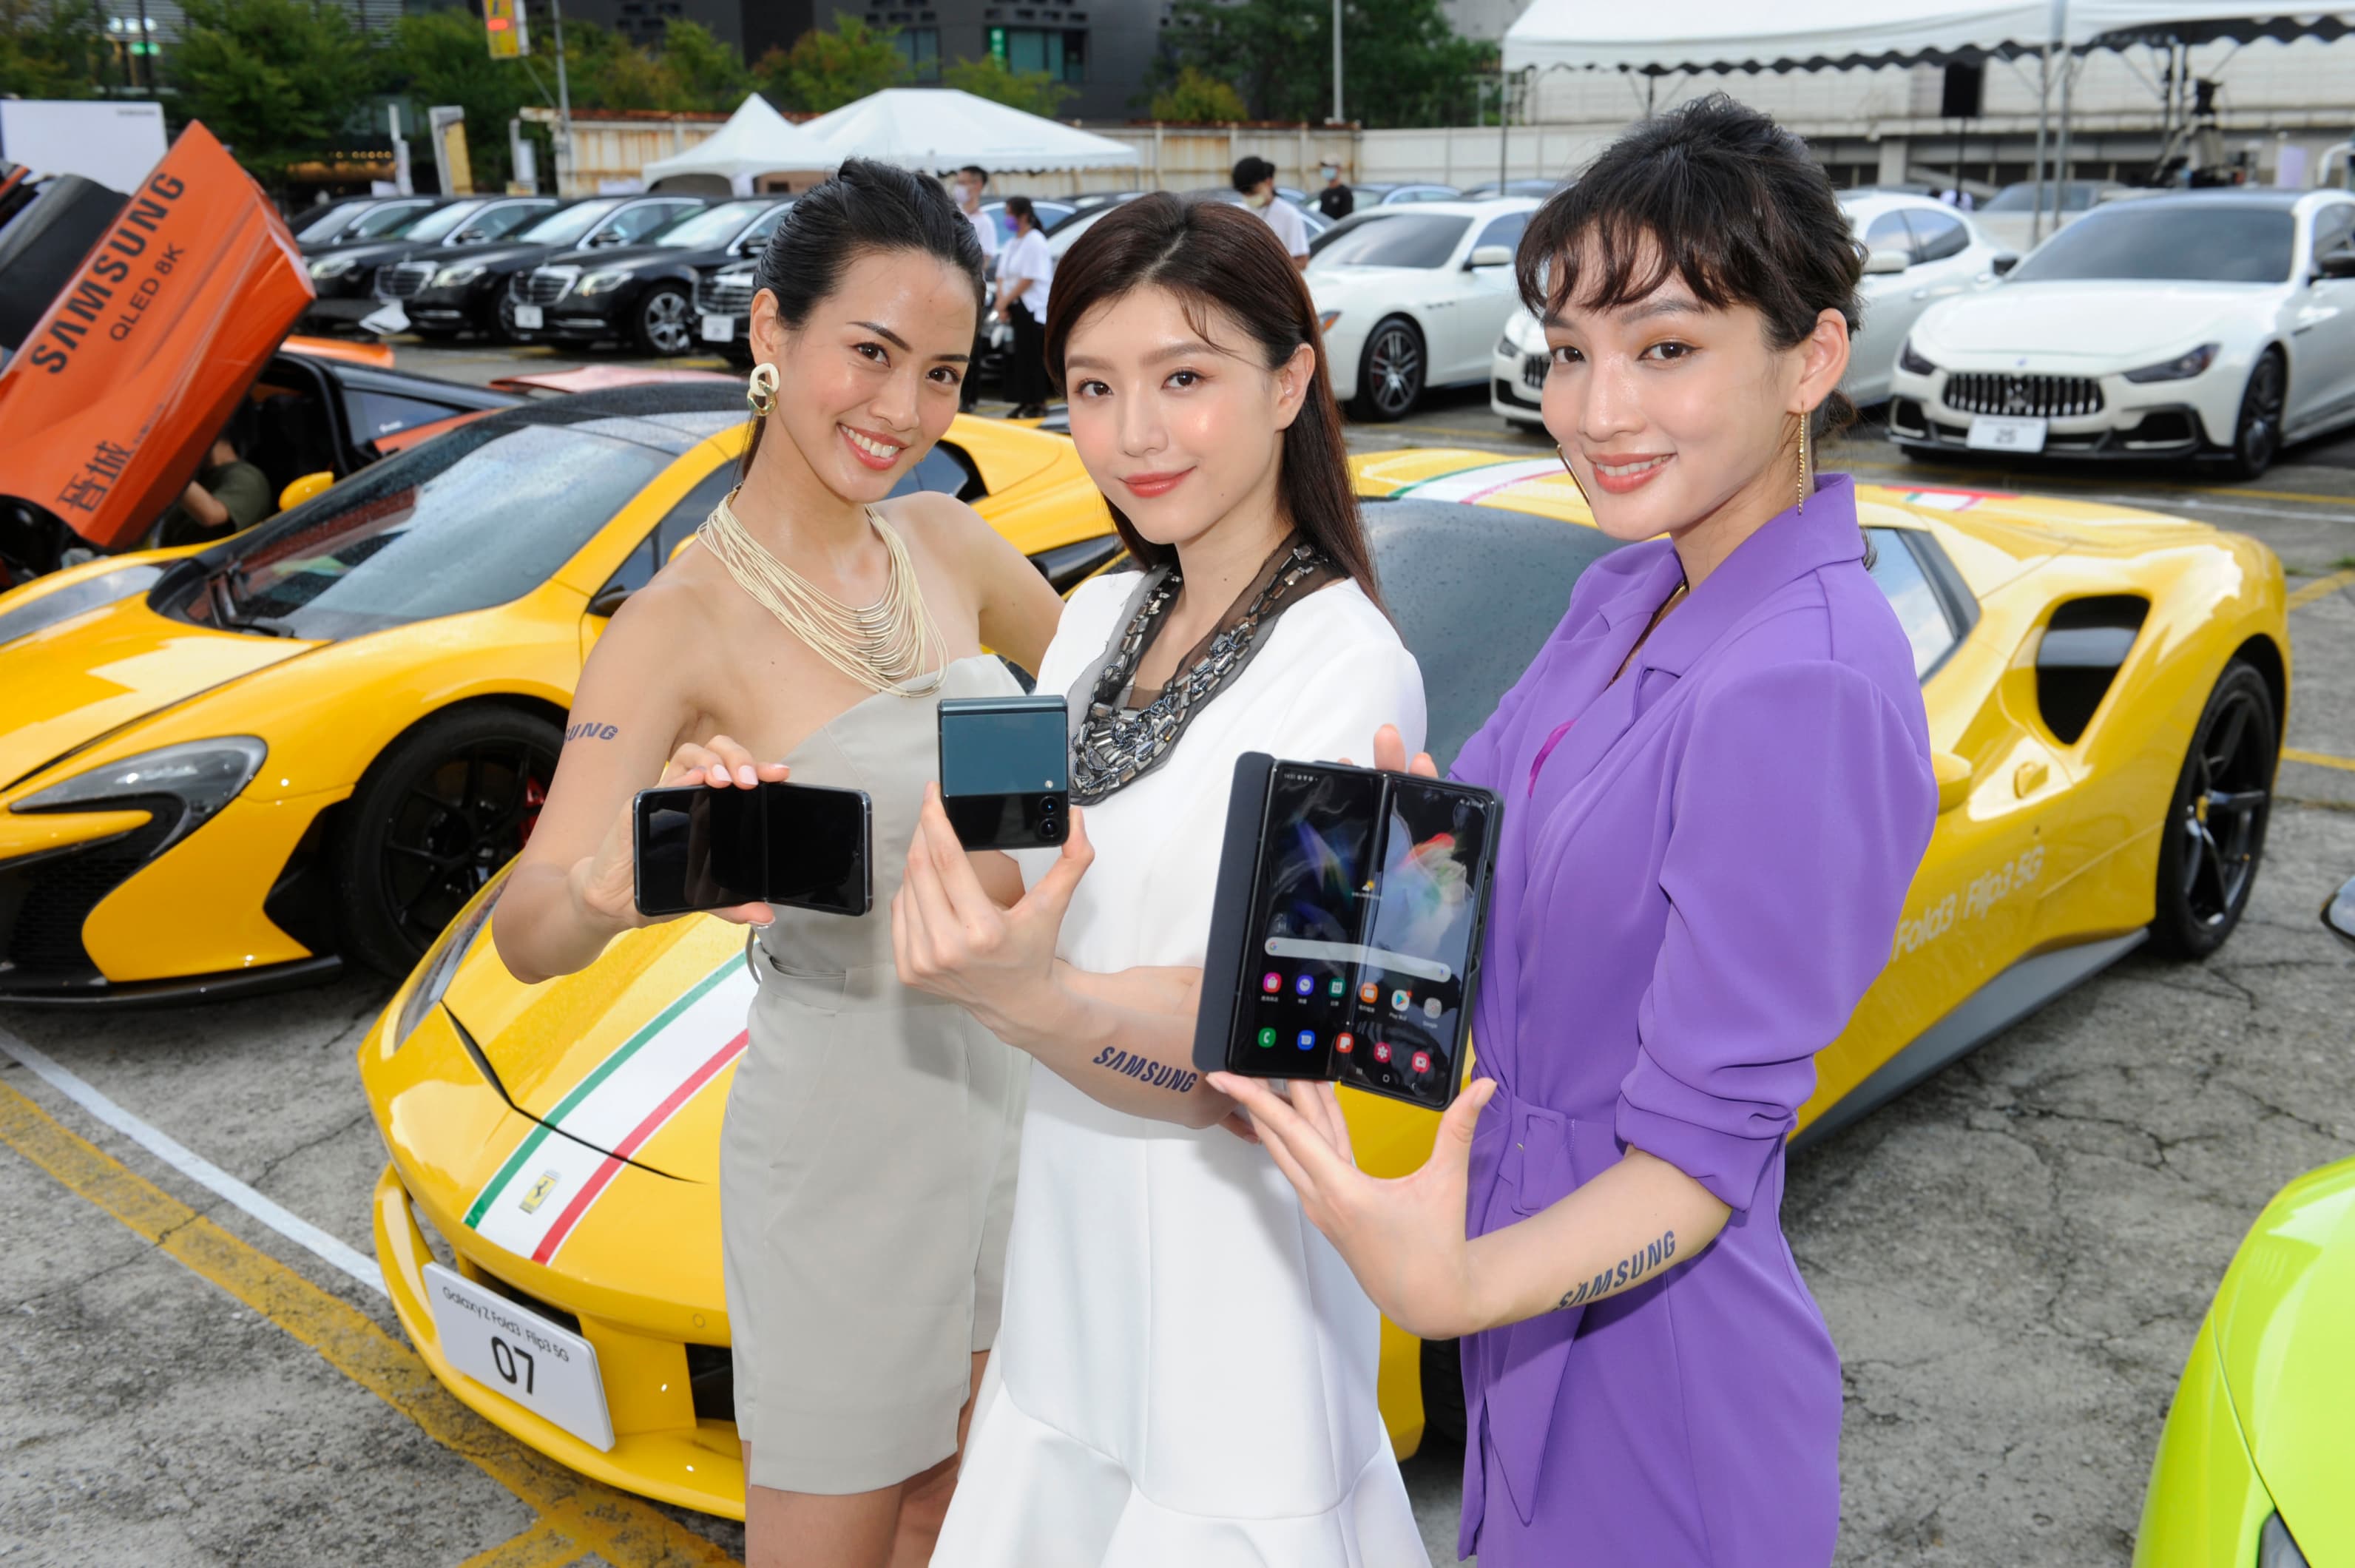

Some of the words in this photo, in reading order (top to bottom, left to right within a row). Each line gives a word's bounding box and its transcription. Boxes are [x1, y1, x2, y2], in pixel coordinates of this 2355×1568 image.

[30, 173, 184, 374] SAMSUNG
[109, 277, 160, 341] QLED
[154, 243, 185, 275] 8K
[1893, 893, 1956, 963] Fold3
[1963, 861, 2014, 920] Flip3
[2014, 845, 2045, 890] 5G
[1092, 1046, 1198, 1092] SAMSUNG
[1551, 1230, 1676, 1312] SAMSUNG
[442, 1286, 482, 1318] Galaxy
[482, 1306, 490, 1320] Z
[491, 1311, 521, 1336] Fold3
[525, 1330, 551, 1353] Flip3
[553, 1345, 569, 1362] 5G
[491, 1336, 534, 1395] 07
